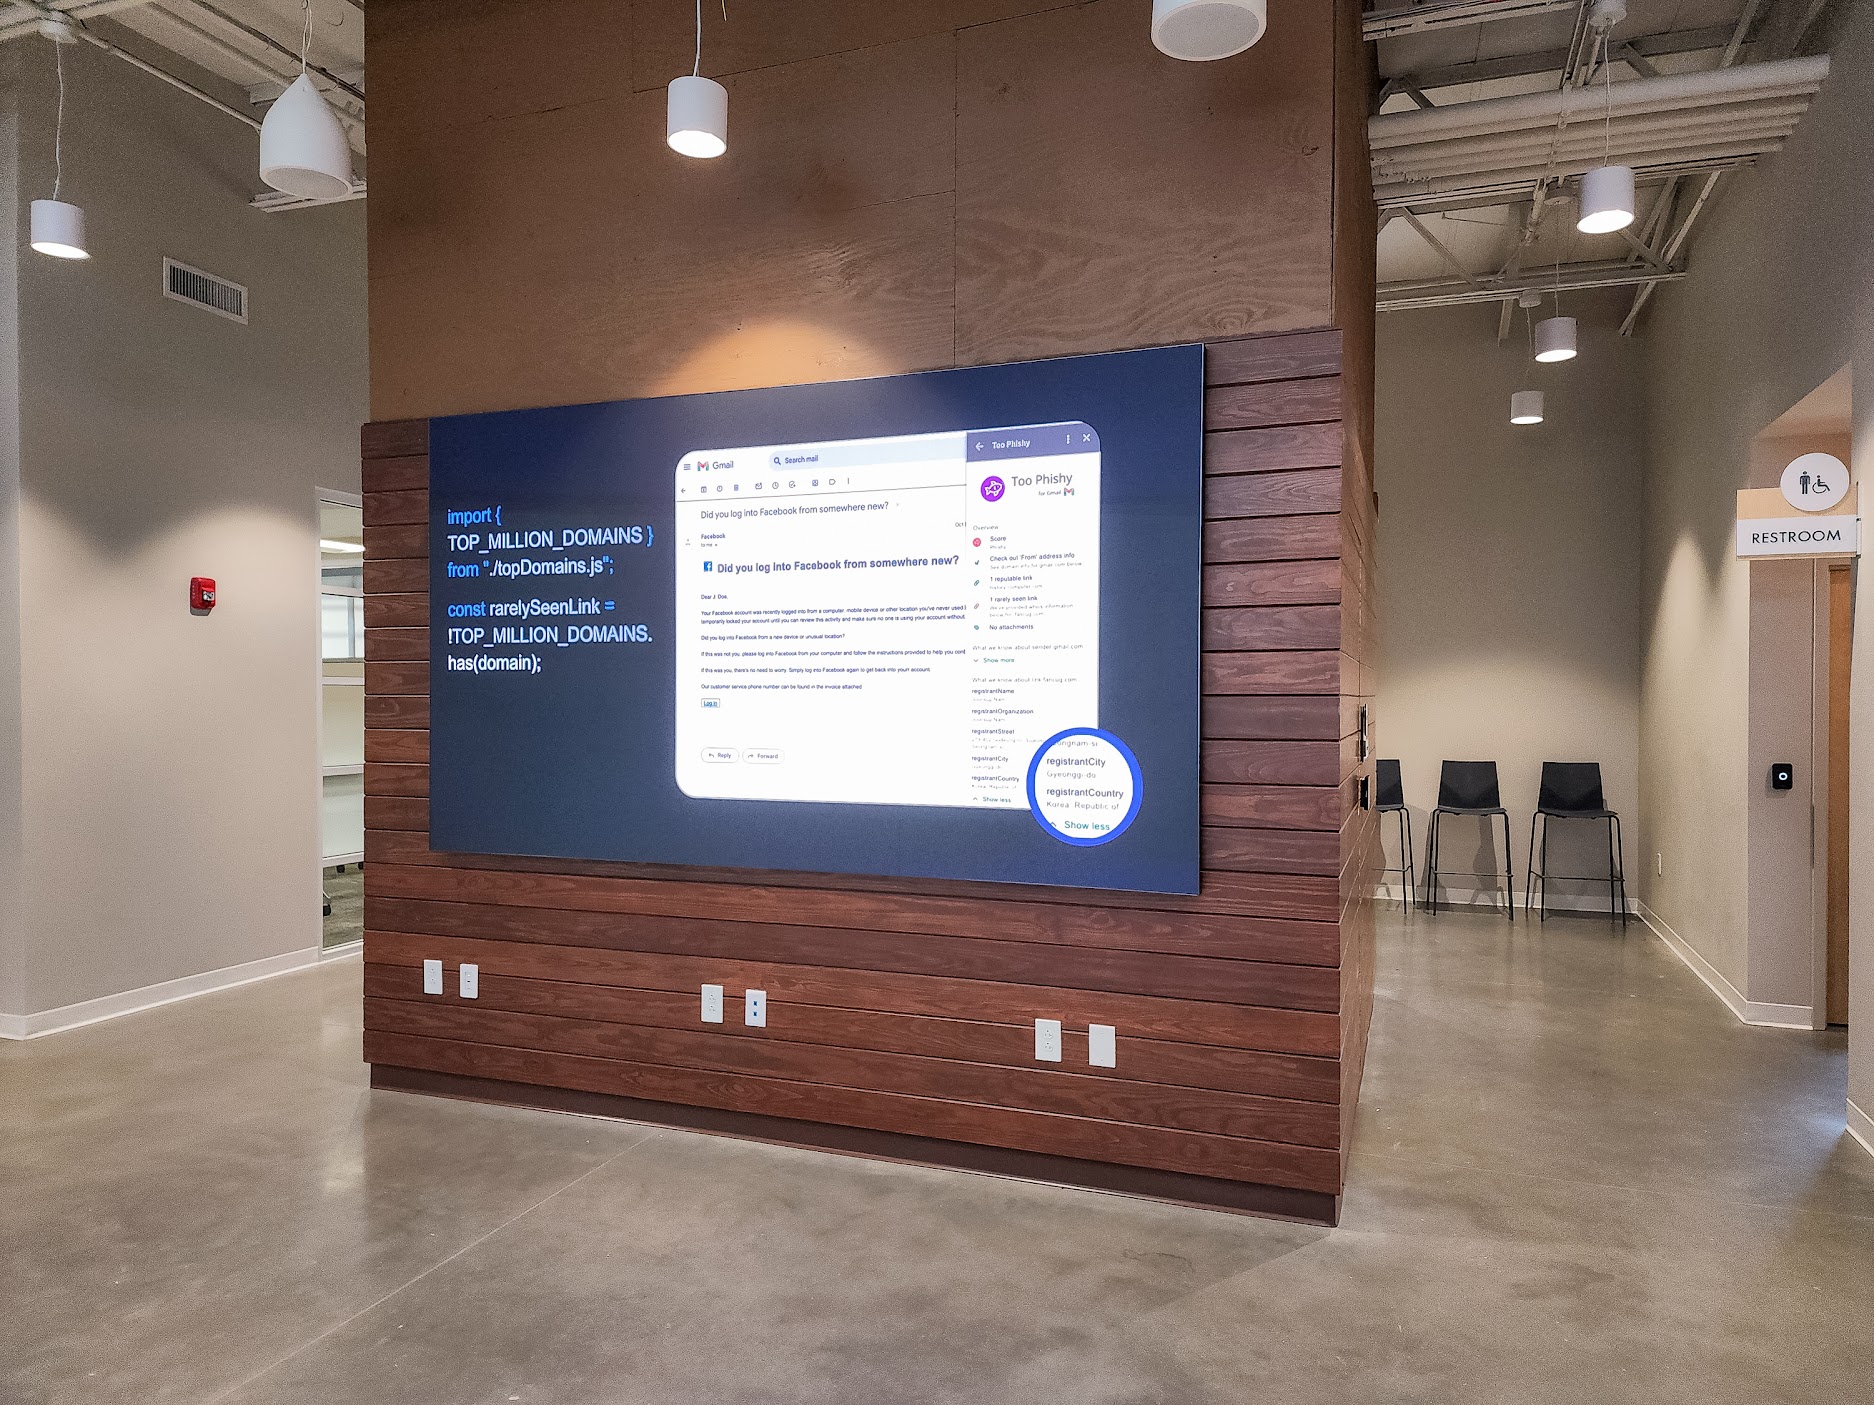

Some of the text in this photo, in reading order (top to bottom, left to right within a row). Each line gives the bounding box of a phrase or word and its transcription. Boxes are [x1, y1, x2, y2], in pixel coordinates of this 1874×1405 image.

[1006, 439, 1030, 448] Phishy
[712, 460, 734, 470] Gmail
[1012, 473, 1072, 486] Too Phishy
[447, 505, 502, 527] import {
[715, 511, 729, 520] you
[730, 510, 742, 519] log
[760, 507, 797, 516] Facebook
[799, 506, 817, 514] from
[819, 502, 865, 513] somewhere
[867, 502, 889, 510] new?
[447, 525, 654, 554] TOP_MILLION_DOMAINS }
[1752, 530, 1841, 544] RESTROOM
[447, 555, 615, 579] from "./topDomains.js";
[718, 564, 733, 573] Did
[736, 564, 753, 574] you
[756, 563, 771, 573] log
[794, 560, 841, 570] Facebook
[844, 560, 867, 568] from
[870, 557, 928, 568] somewhere
[931, 555, 959, 566] new?
[448, 597, 615, 619] const rarelySeenLink =
[448, 625, 653, 648] !TOP_MILLION_DOMAINS.
[448, 654, 542, 674] has(domain);
[1046, 758, 1106, 768] registrantCity
[1046, 789, 1124, 799] registrantCountry
[1064, 821, 1089, 830] Show
